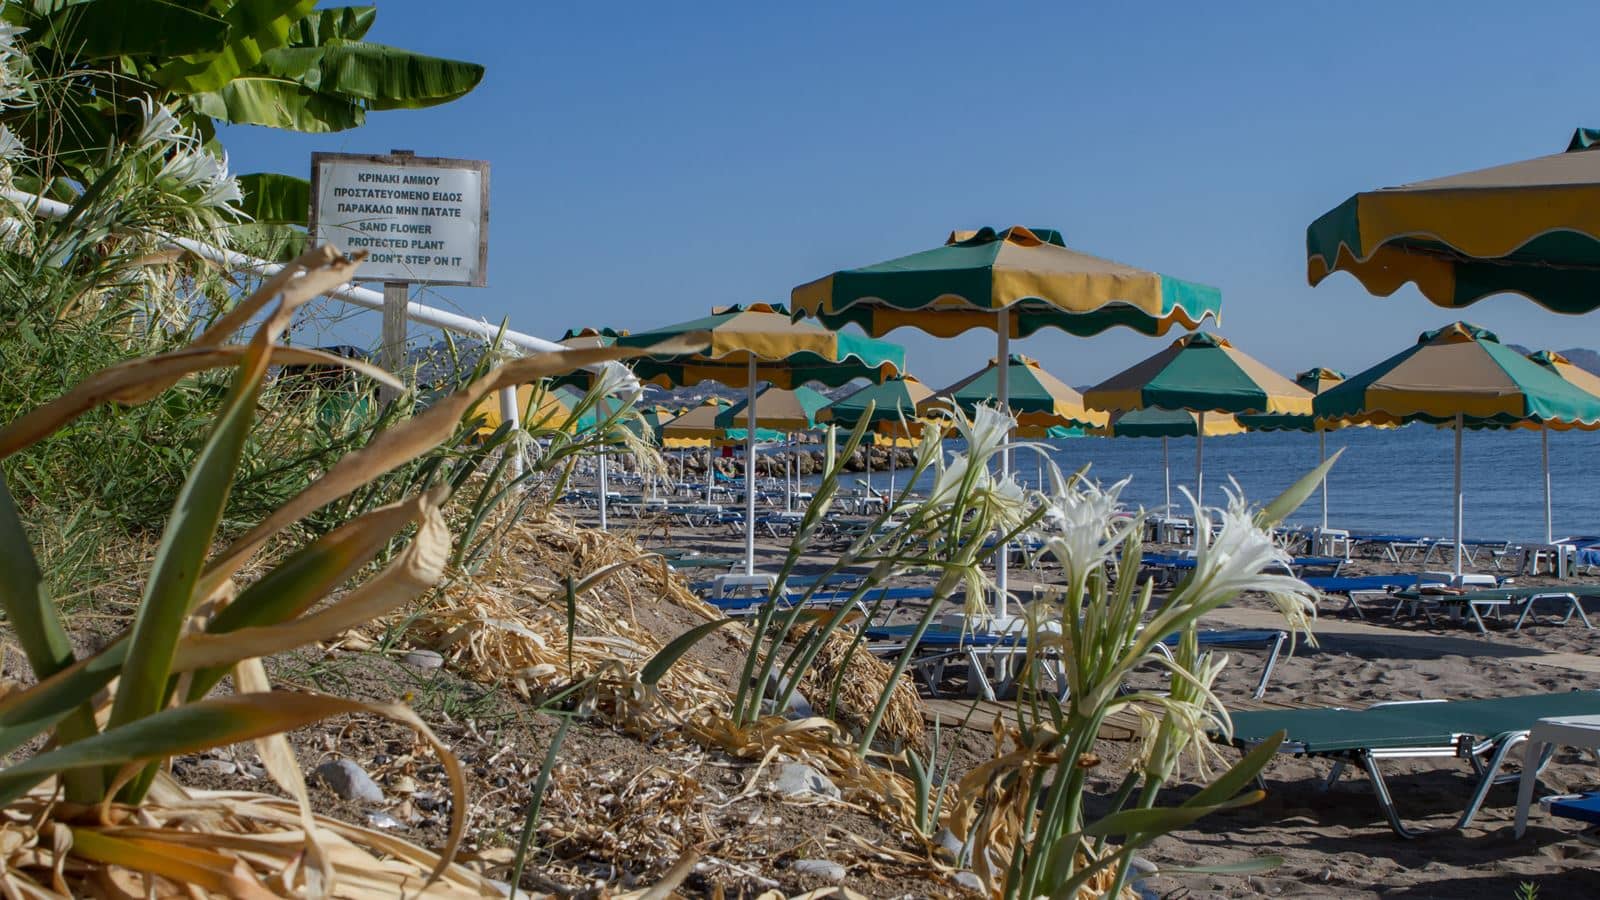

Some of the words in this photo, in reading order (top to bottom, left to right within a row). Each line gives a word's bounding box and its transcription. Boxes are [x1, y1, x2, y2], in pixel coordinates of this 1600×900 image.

[358, 173, 400, 183] ΚΡΙΝΑΚΙ
[402, 176, 439, 185] ΑΜΜΟΥ
[334, 188, 430, 201] ΠΡΟΣΤΑΤΕΥΟΜΕΝΟ
[433, 193, 462, 201] ΕΙΔΟΣ
[338, 204, 393, 214] ΠΑΡΑΚΑΛΩ
[396, 206, 418, 215] ΜΗΝ
[421, 208, 461, 217] ΠΑΤΑΤΕ
[360, 222, 387, 232] SAND
[391, 225, 431, 234] FLOWER
[348, 237, 408, 248] PROTECTED
[412, 240, 444, 249] PLANT
[372, 254, 402, 263] DON'T
[405, 256, 430, 264] STEP
[434, 258, 448, 266] ON
[452, 258, 462, 266] IT
